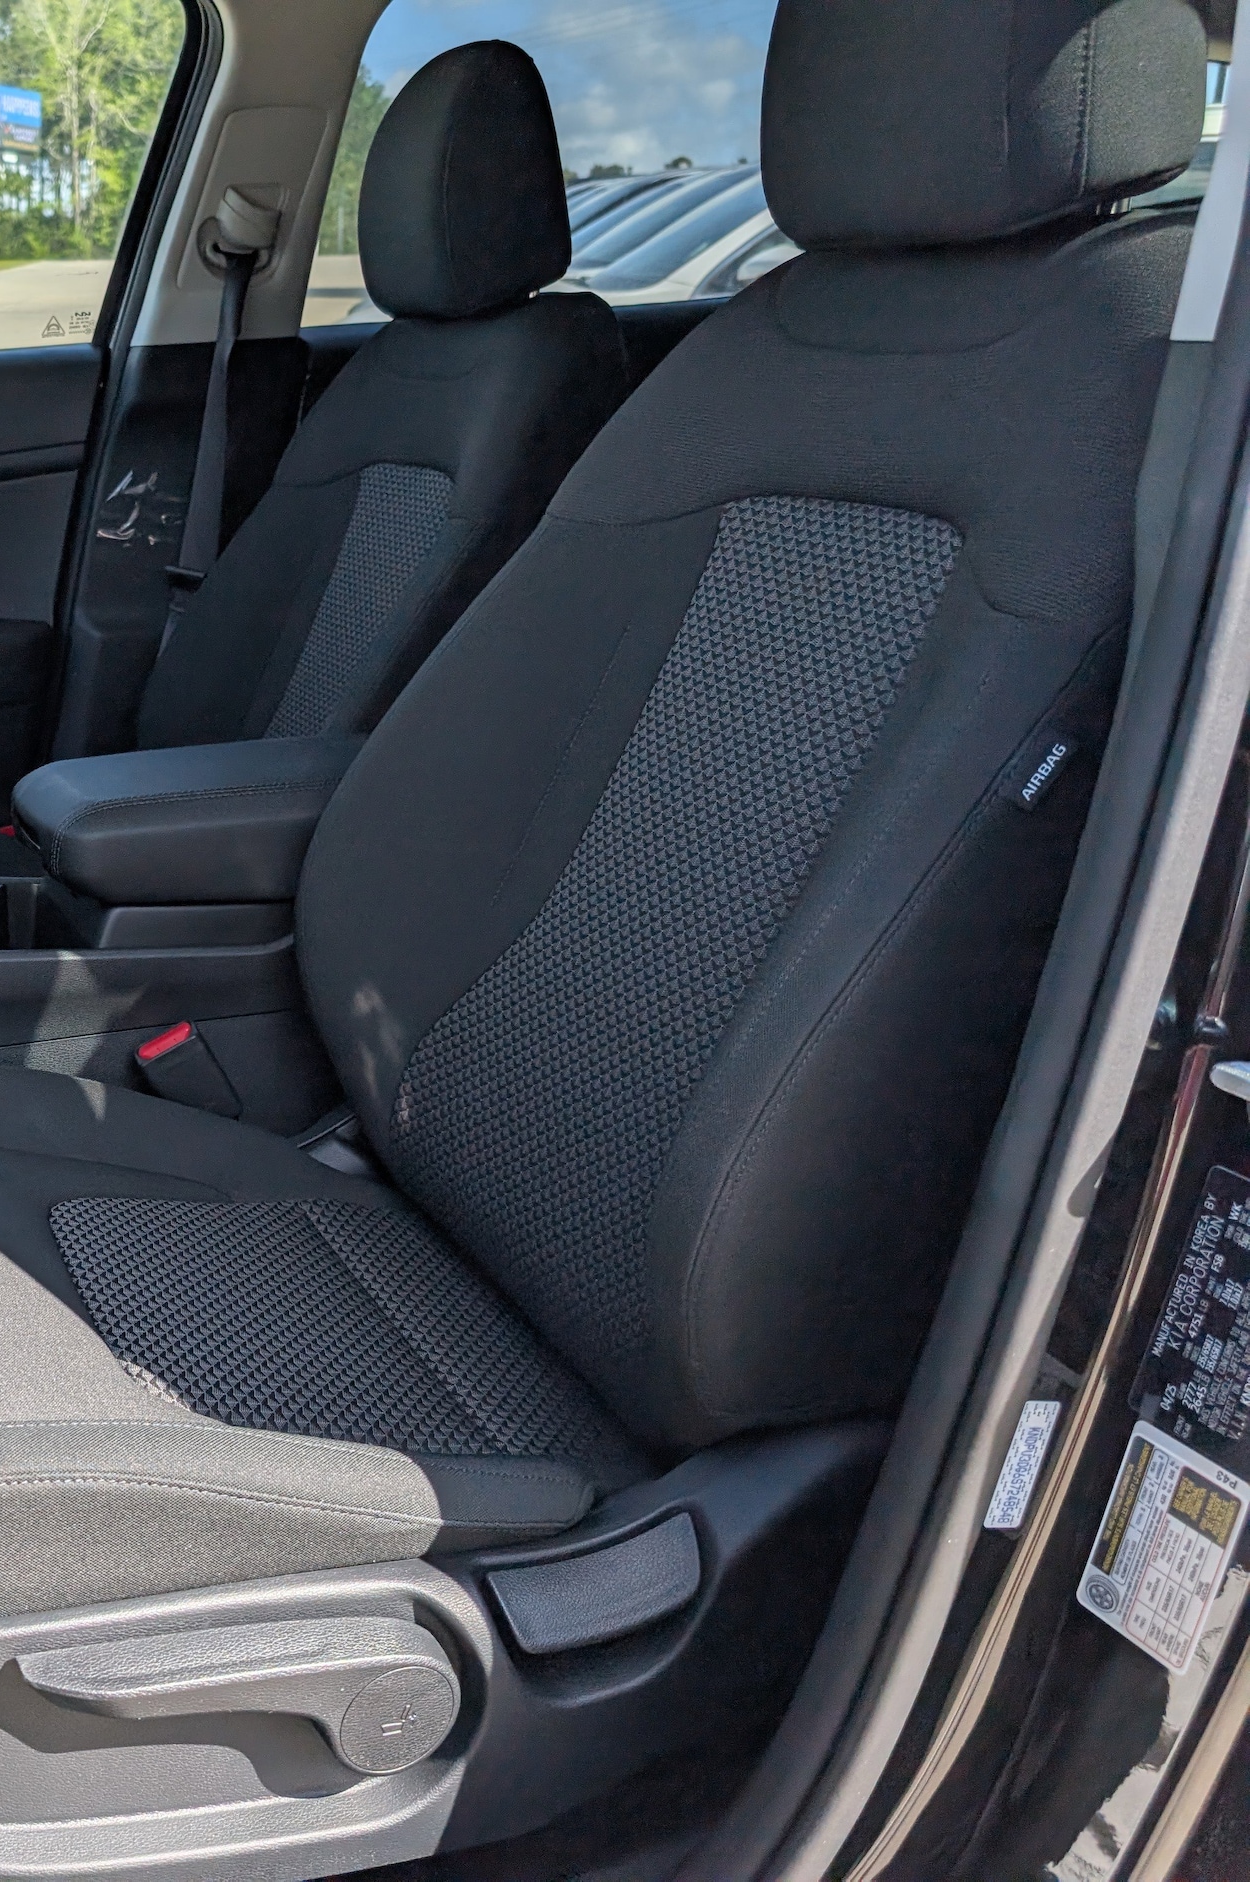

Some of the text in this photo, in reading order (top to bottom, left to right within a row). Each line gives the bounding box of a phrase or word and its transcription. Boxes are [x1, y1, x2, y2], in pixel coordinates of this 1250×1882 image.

[1021, 743, 1067, 802] AIRBAG
[1227, 1200, 1242, 1221] WK
[1150, 1191, 1217, 1357] MANUFACTURED IN KOREA BY
[1210, 1252, 1224, 1272] FSB
[1166, 1213, 1224, 1350] KIA CORPORATION
[1186, 1311, 1203, 1339] 4751
[1158, 1382, 1178, 1411] 04/25
[1181, 1380, 1198, 1409] 2777
[1189, 1383, 1207, 1413] 2645
[1215, 1469, 1240, 1490] P43
